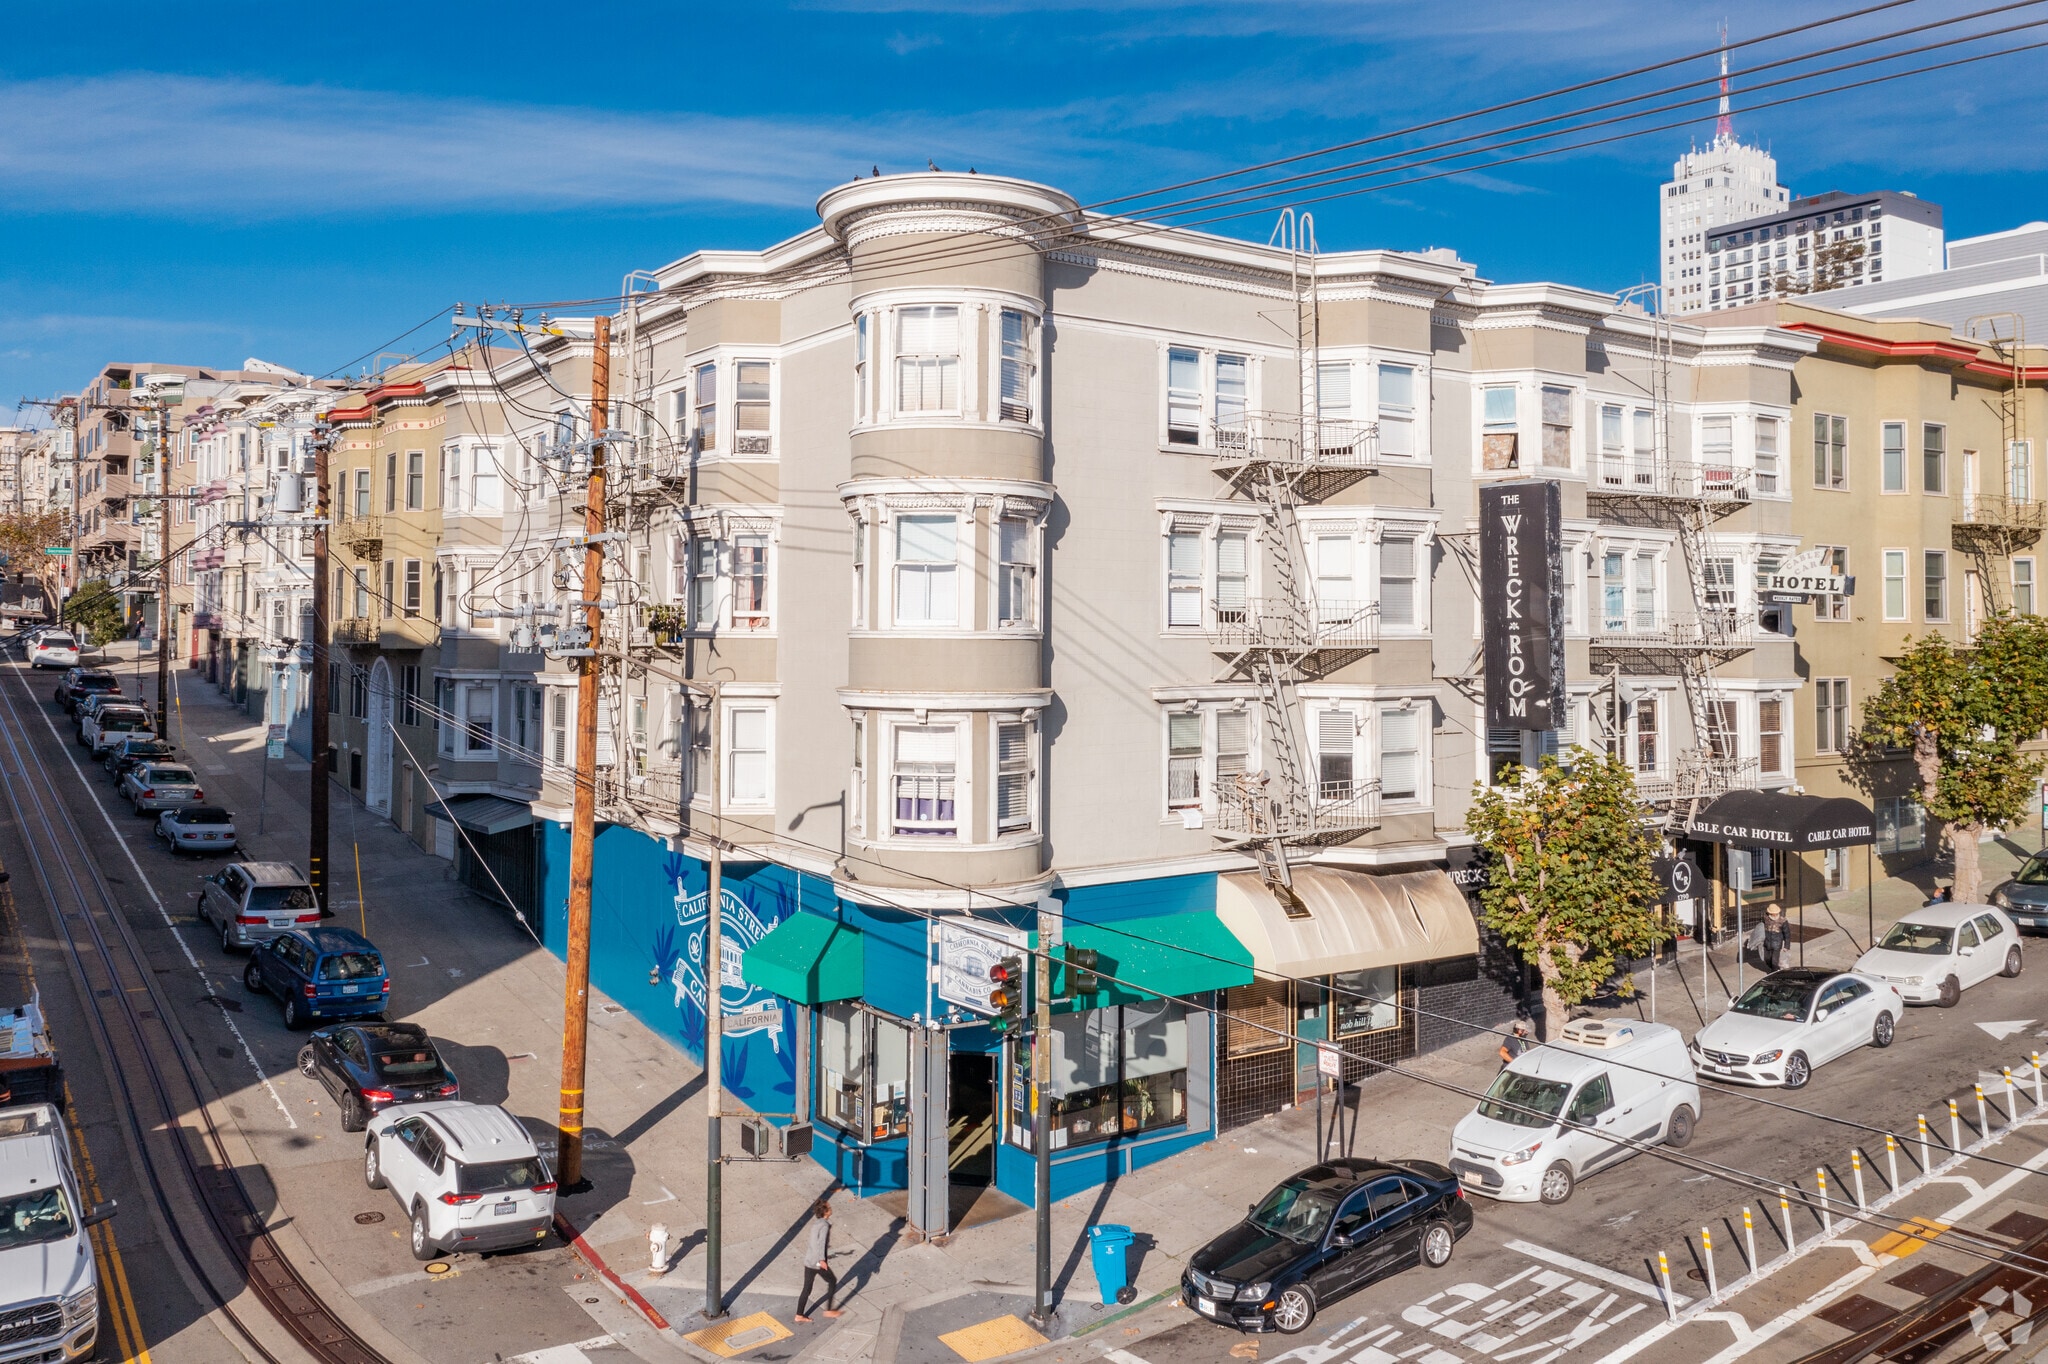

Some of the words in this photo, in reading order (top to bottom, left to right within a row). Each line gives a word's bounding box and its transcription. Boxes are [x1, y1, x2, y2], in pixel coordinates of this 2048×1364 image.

[1501, 494, 1520, 505] THE
[1501, 514, 1523, 619] WRECK
[1787, 551, 1820, 569] CABLE
[1795, 561, 1817, 574] CAR
[1773, 576, 1839, 591] HOTEL
[1508, 634, 1527, 717] ROOM
[1723, 825, 1748, 837] CAR
[1751, 828, 1793, 842] HOTEL
[1808, 830, 1831, 842] CABLE
[1832, 828, 1847, 839] CAR
[1848, 826, 1871, 837] HOTEL
[1446, 869, 1485, 884] WRECK
[682, 895, 736, 917] CALIFNIA
[738, 907, 766, 940] STREE
[949, 939, 979, 950] CALIFORNIA
[981, 945, 999, 963] STREET
[954, 975, 982, 995] CANNABIS
[727, 1014, 778, 1028] CALIFORNIA
[1340, 1019, 1353, 1030] nob
[1354, 1016, 1366, 1027] hill
[1401, 1264, 1648, 1364] KEEP
[0, 1319, 31, 1330] AM
